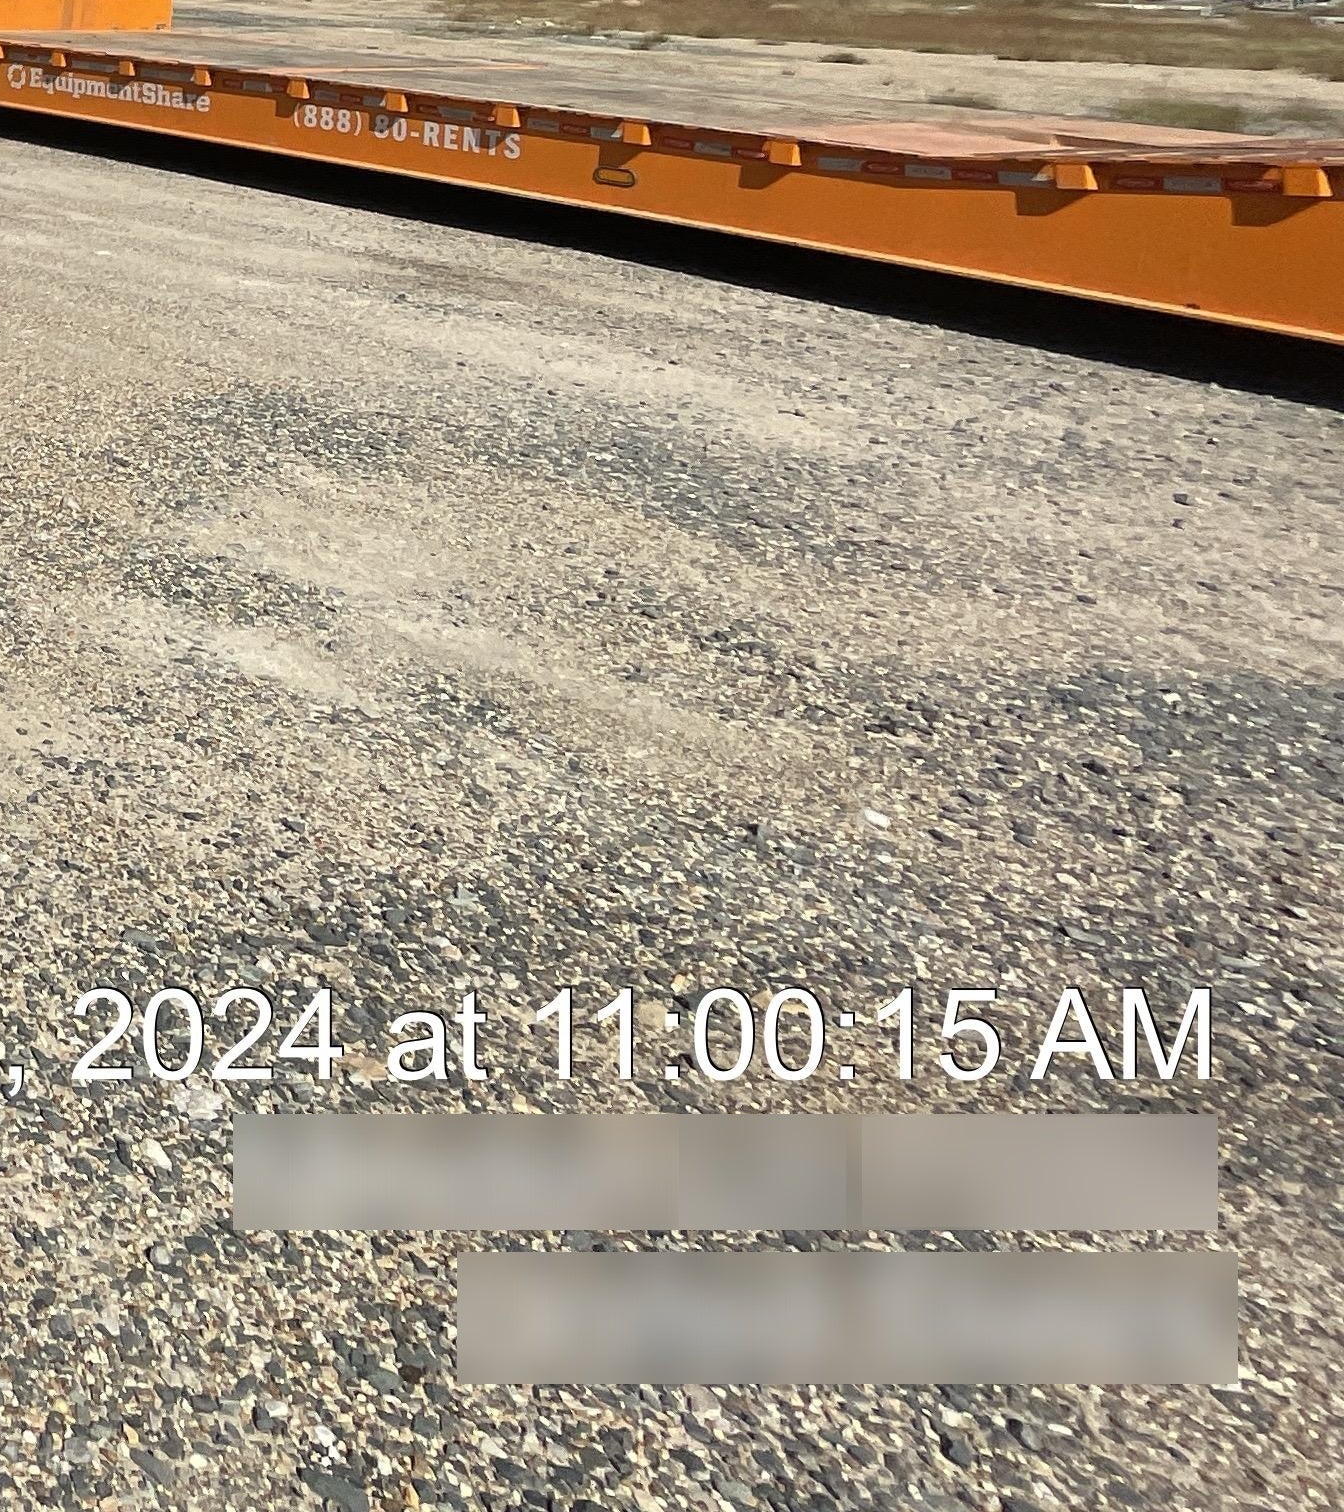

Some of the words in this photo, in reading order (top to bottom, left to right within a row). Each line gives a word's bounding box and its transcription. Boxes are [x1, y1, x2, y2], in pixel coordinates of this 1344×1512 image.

[29, 66, 211, 113] EquipmentShare
[292, 102, 362, 137] (888)
[373, 113, 522, 160] 80-RENTS
